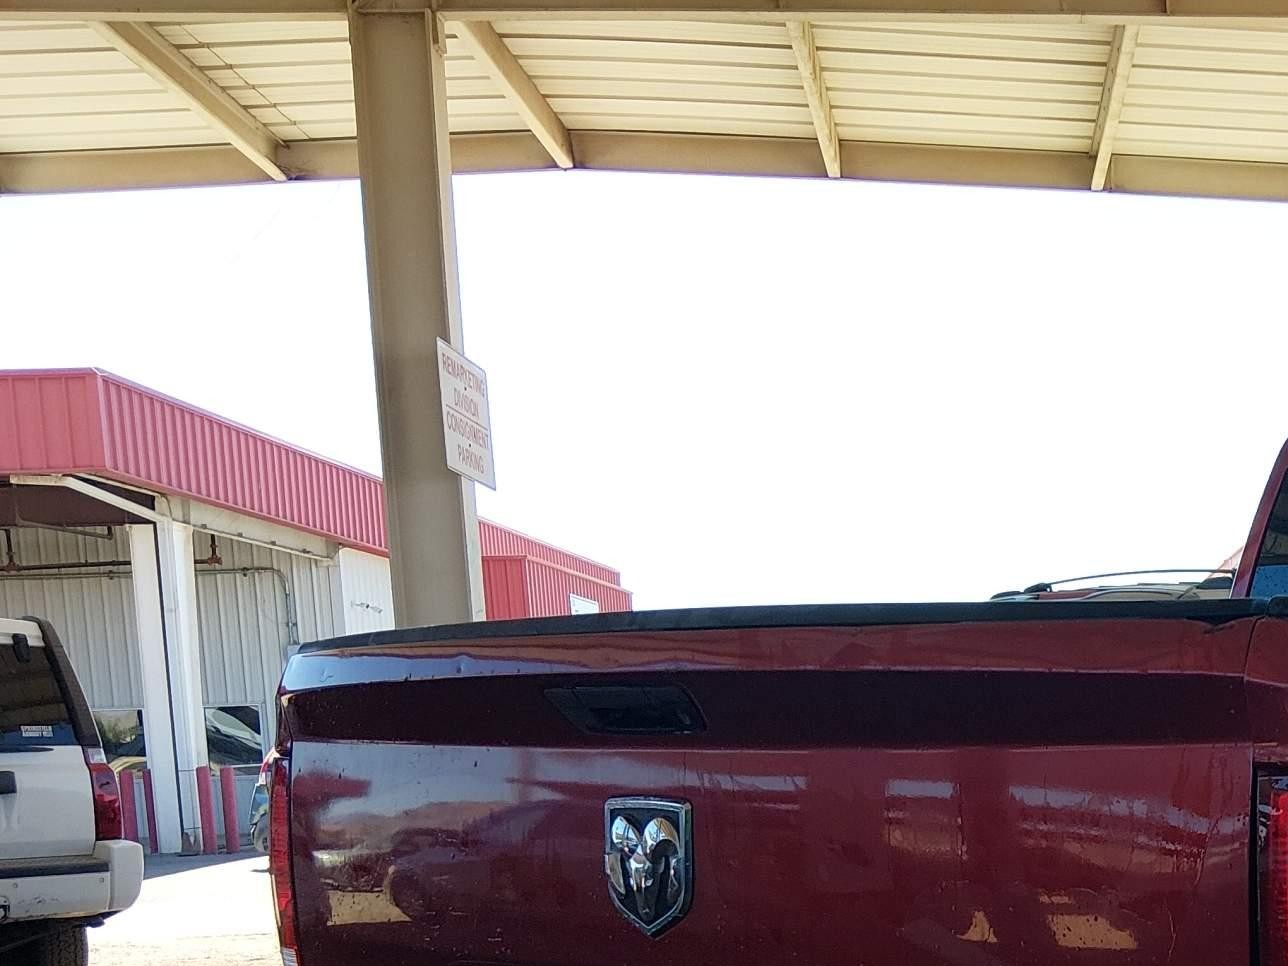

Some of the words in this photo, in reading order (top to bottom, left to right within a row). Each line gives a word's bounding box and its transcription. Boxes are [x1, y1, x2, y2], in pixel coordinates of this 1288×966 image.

[441, 352, 486, 397] REMARKETING
[453, 386, 480, 418] DIVISION
[446, 412, 489, 449] CONSIGNMENT
[457, 444, 485, 474] PARKING
